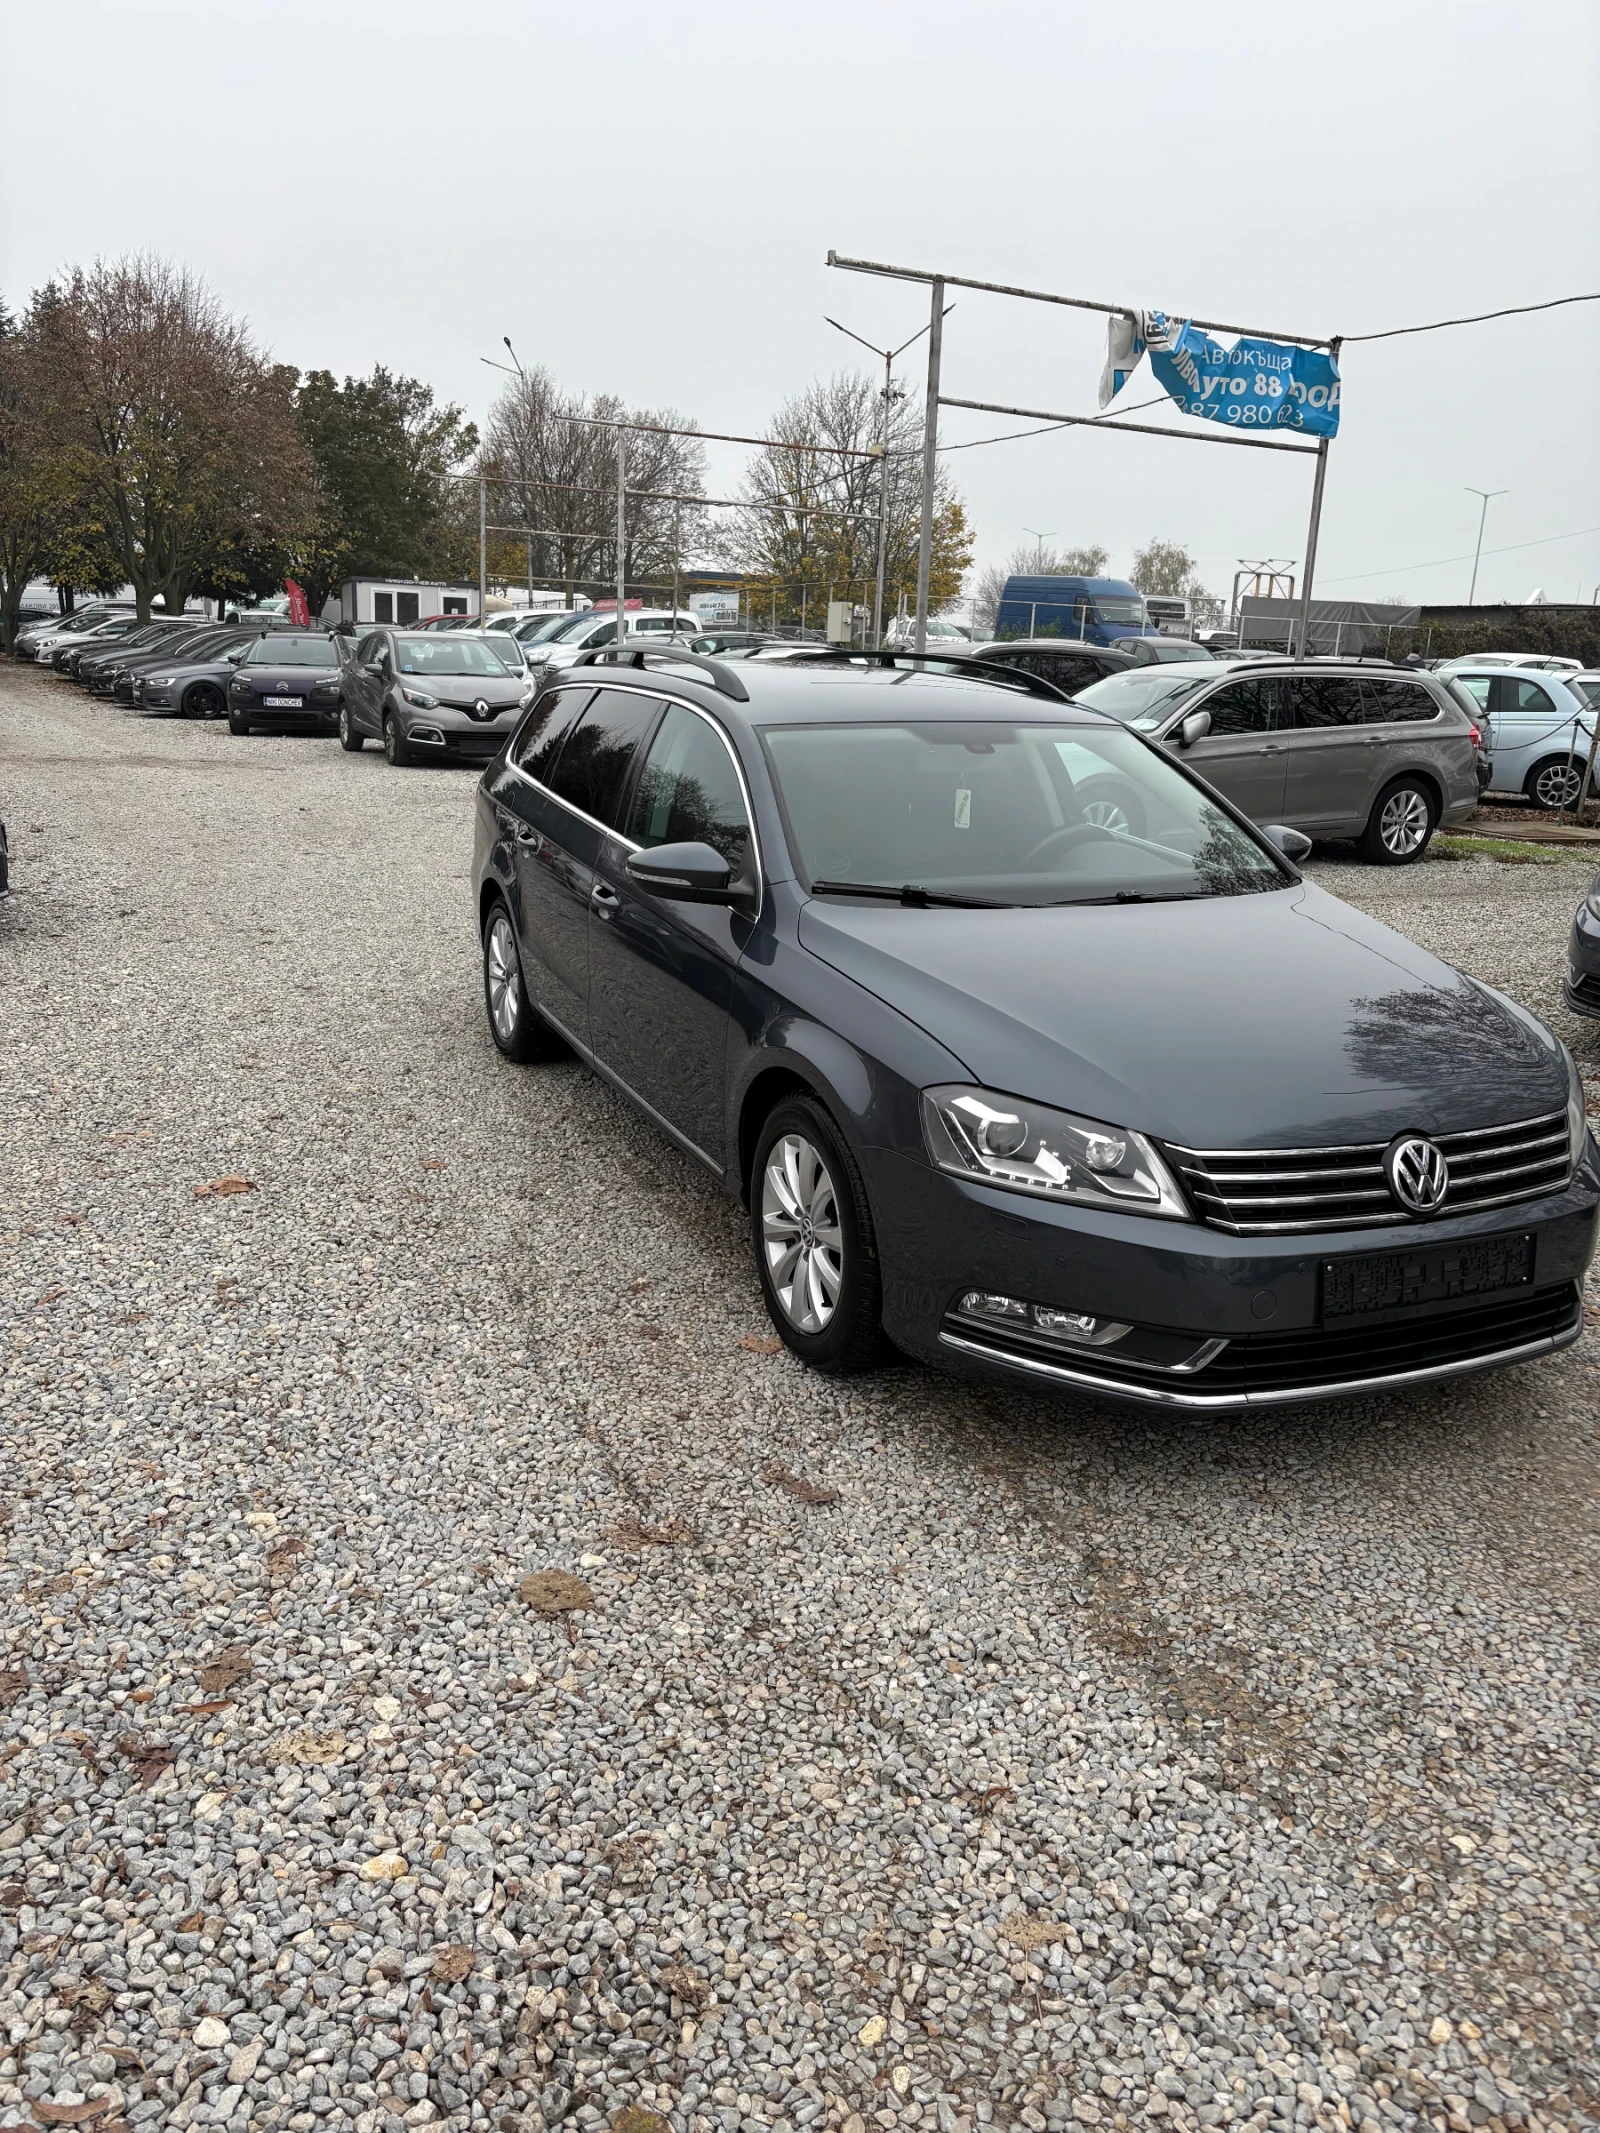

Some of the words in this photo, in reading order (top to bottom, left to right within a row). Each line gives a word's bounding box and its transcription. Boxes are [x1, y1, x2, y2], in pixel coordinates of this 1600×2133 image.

[1253, 373, 1283, 397] 88
[1226, 404, 1272, 424] 980
[1277, 404, 1304, 427] 623
